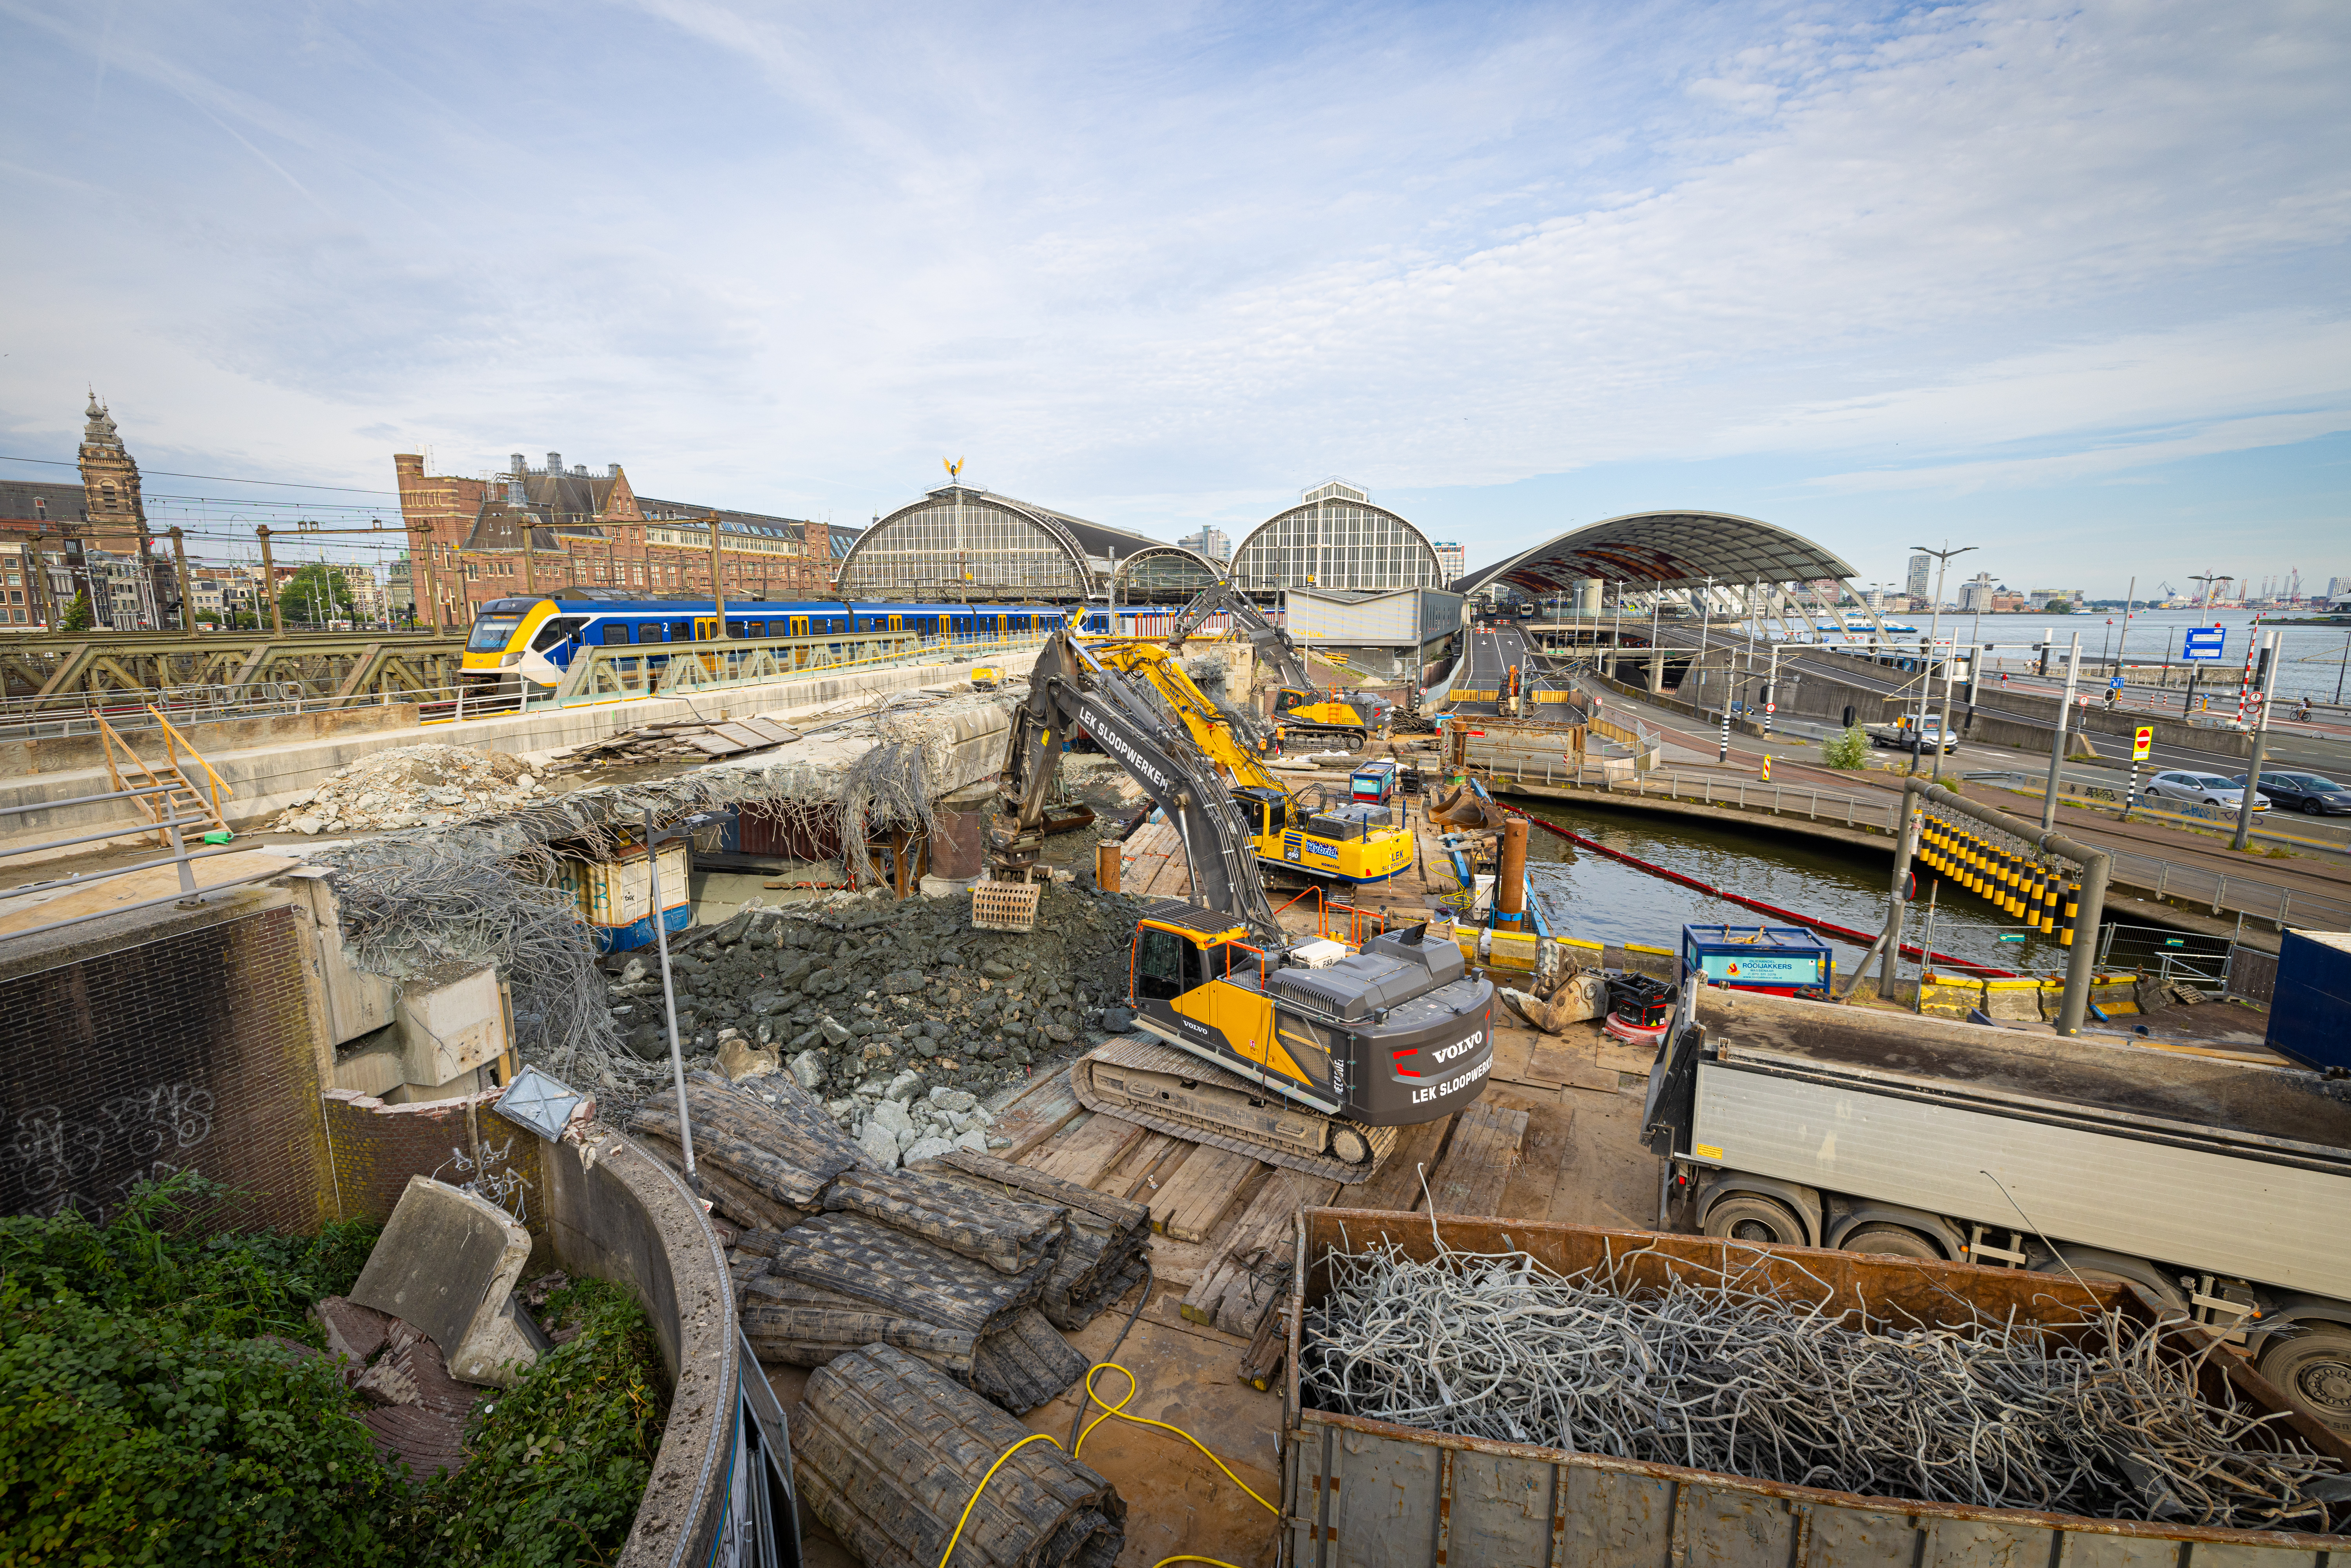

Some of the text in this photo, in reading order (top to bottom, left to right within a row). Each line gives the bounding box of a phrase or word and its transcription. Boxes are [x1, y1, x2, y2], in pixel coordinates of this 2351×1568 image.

[663, 622, 668, 632] 2
[744, 621, 748, 629] 2
[1241, 617, 1255, 629] sloopwerken
[1157, 682, 1185, 714] SLOOPWERKEN
[1080, 706, 1168, 791] LEK SLOOPWERKEN
[1306, 842, 1337, 857] Hybrid
[1392, 849, 1404, 862] LEK
[1183, 1019, 1208, 1035] VOLVO
[1431, 1030, 1482, 1064] VOLVO
[1413, 1050, 1493, 1104] LEK SLOOPWERKEN
